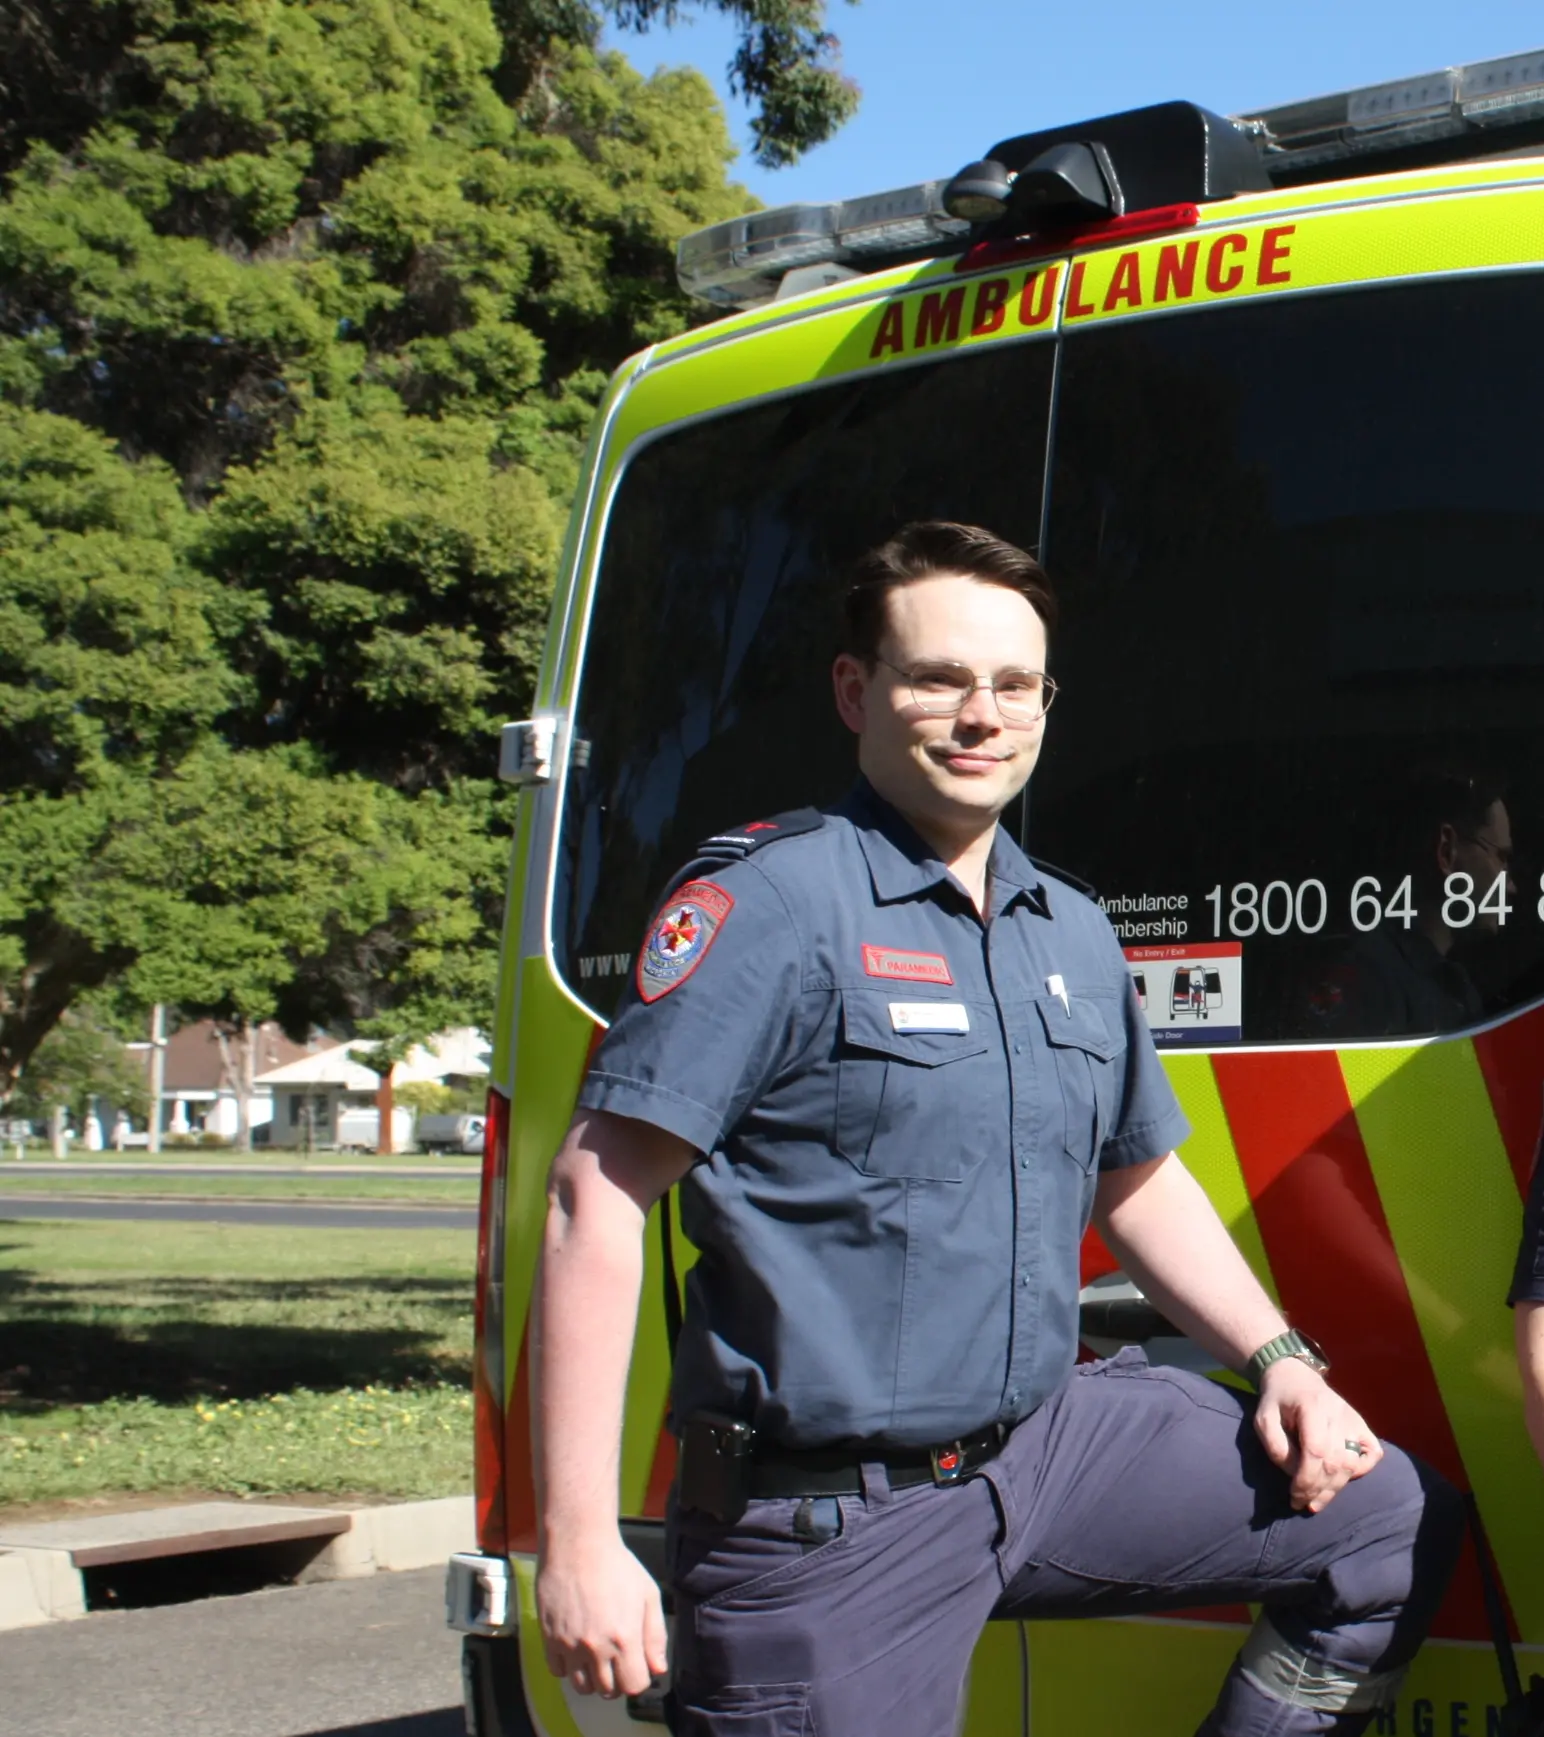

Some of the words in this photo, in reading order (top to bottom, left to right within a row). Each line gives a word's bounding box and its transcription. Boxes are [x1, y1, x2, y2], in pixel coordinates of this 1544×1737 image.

[870, 225, 1296, 358] AMBULANCE
[1098, 894, 1188, 914] Ambulance
[1205, 879, 1328, 938] 1800
[1350, 874, 1418, 932] 64
[1441, 870, 1513, 929] 84
[1112, 917, 1188, 938] mbership
[1144, 949, 1165, 958] Entry
[1171, 948, 1186, 956] Exit
[1165, 1031, 1184, 1039] Door
